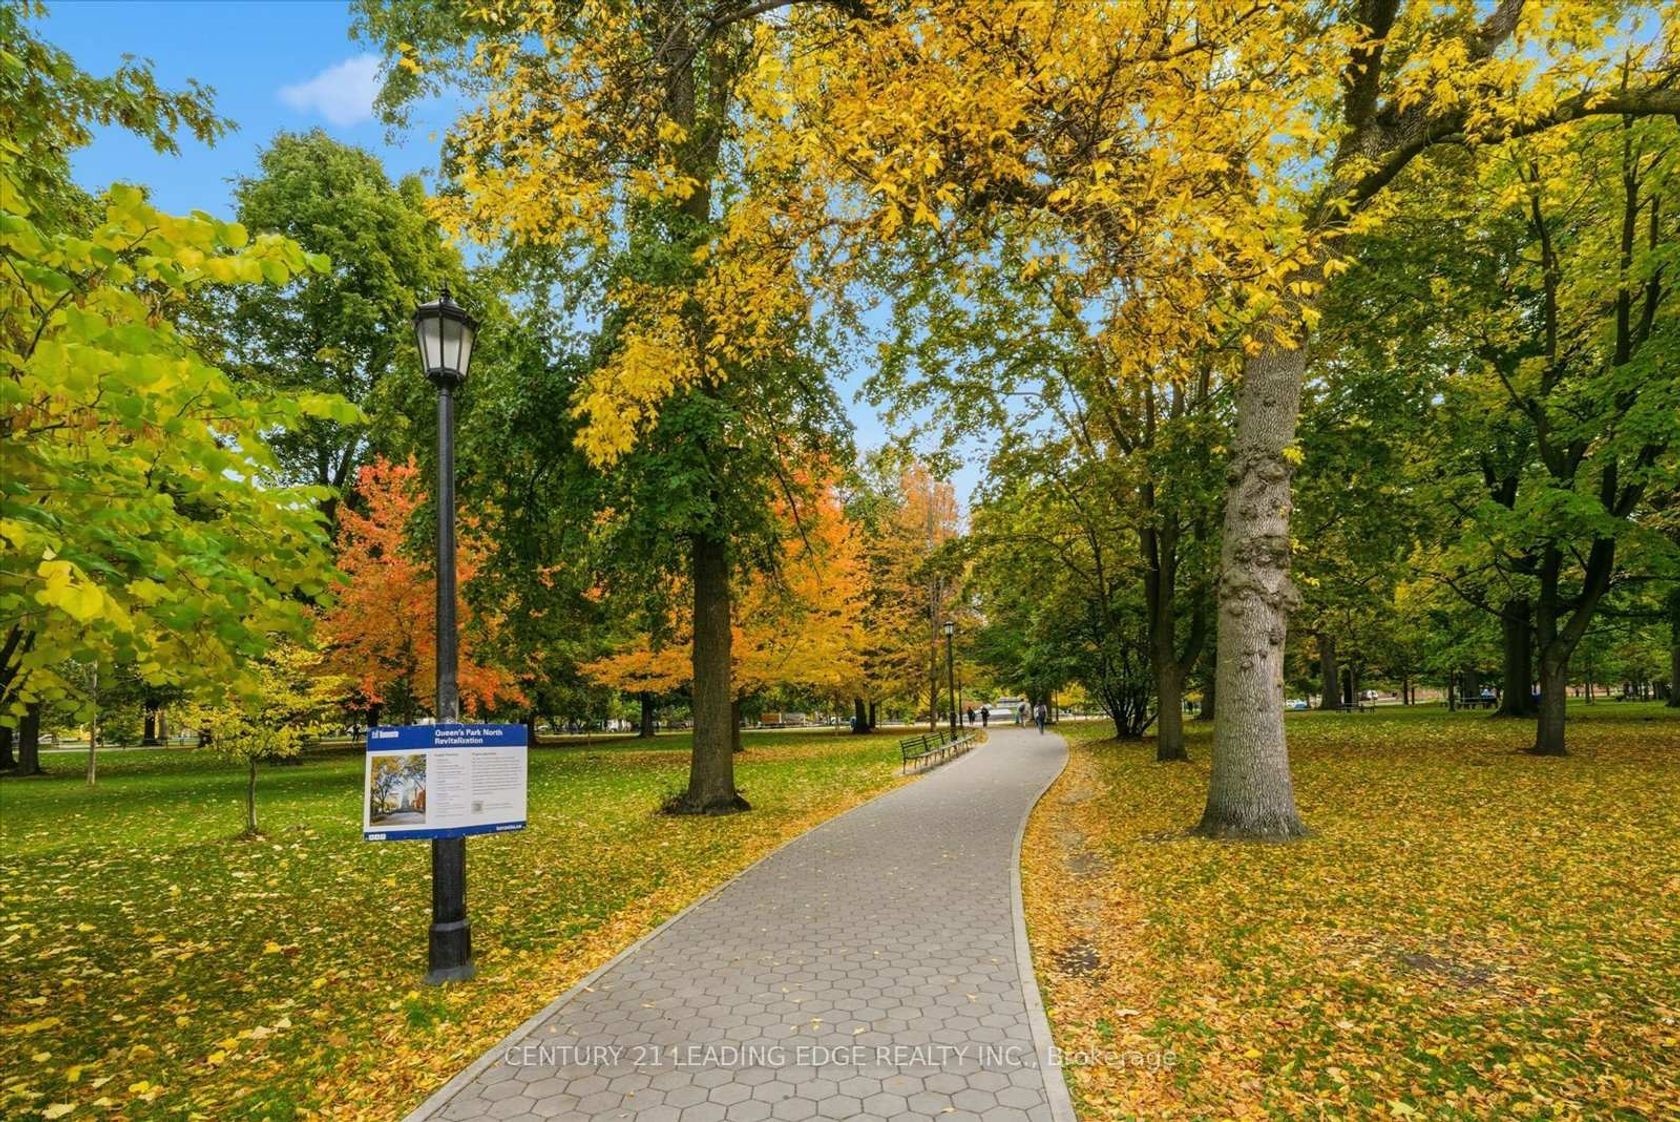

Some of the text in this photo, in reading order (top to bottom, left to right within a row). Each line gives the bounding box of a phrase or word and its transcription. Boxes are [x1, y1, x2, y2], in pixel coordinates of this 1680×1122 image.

[435, 729, 465, 737] Queen's
[483, 728, 503, 736] North
[434, 737, 484, 745] Revitalization
